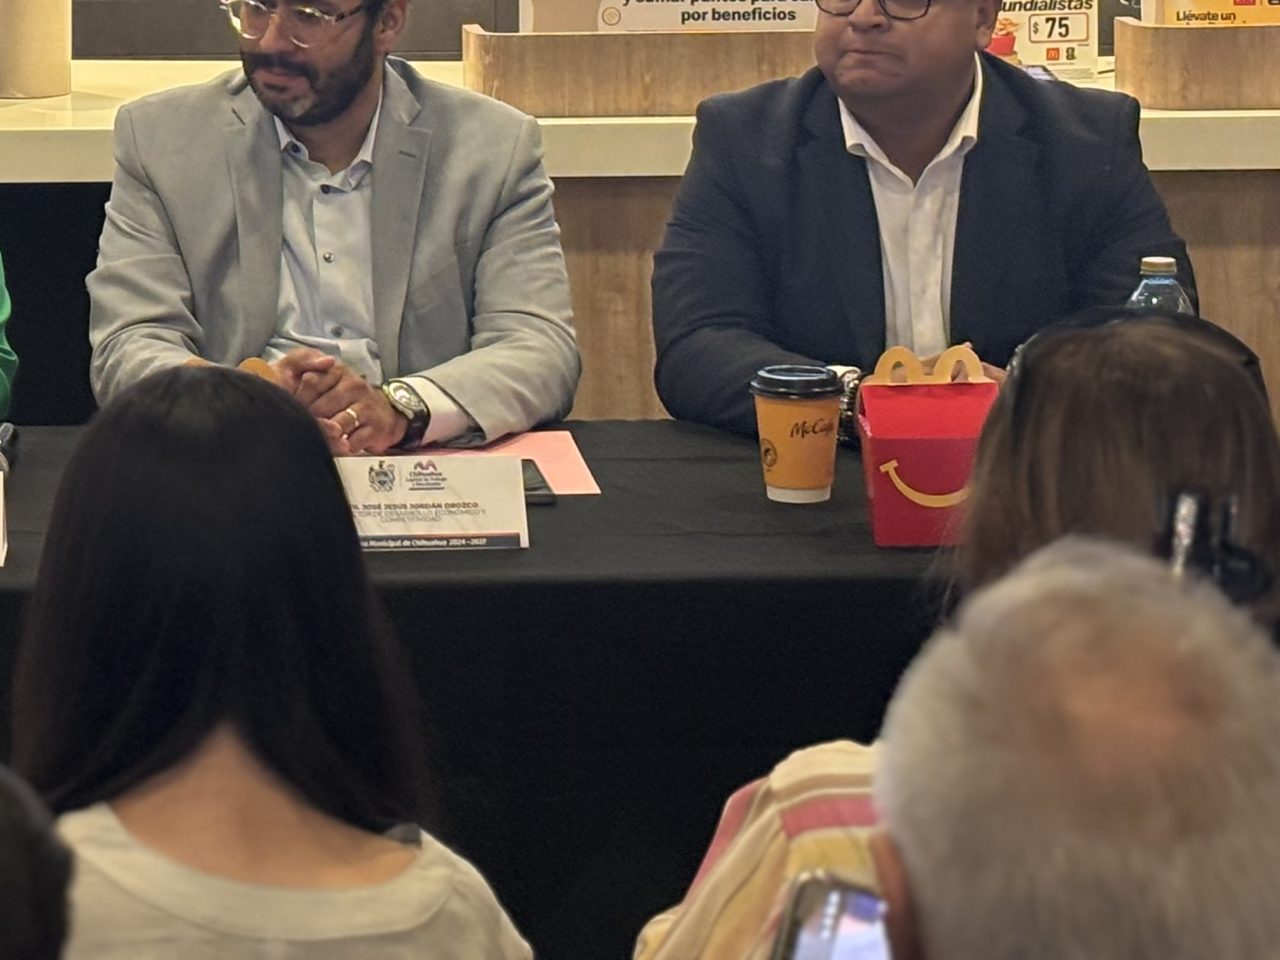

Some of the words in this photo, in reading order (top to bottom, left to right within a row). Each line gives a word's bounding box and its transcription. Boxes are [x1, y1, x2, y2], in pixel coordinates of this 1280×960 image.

[681, 10, 708, 25] por
[711, 7, 797, 22] beneficios
[1176, 10, 1219, 21] Llévate
[1221, 11, 1237, 22] un
[362, 502, 381, 510] JOSÉ
[370, 539, 402, 548] Municipal
[412, 538, 448, 546] Chihuahua
